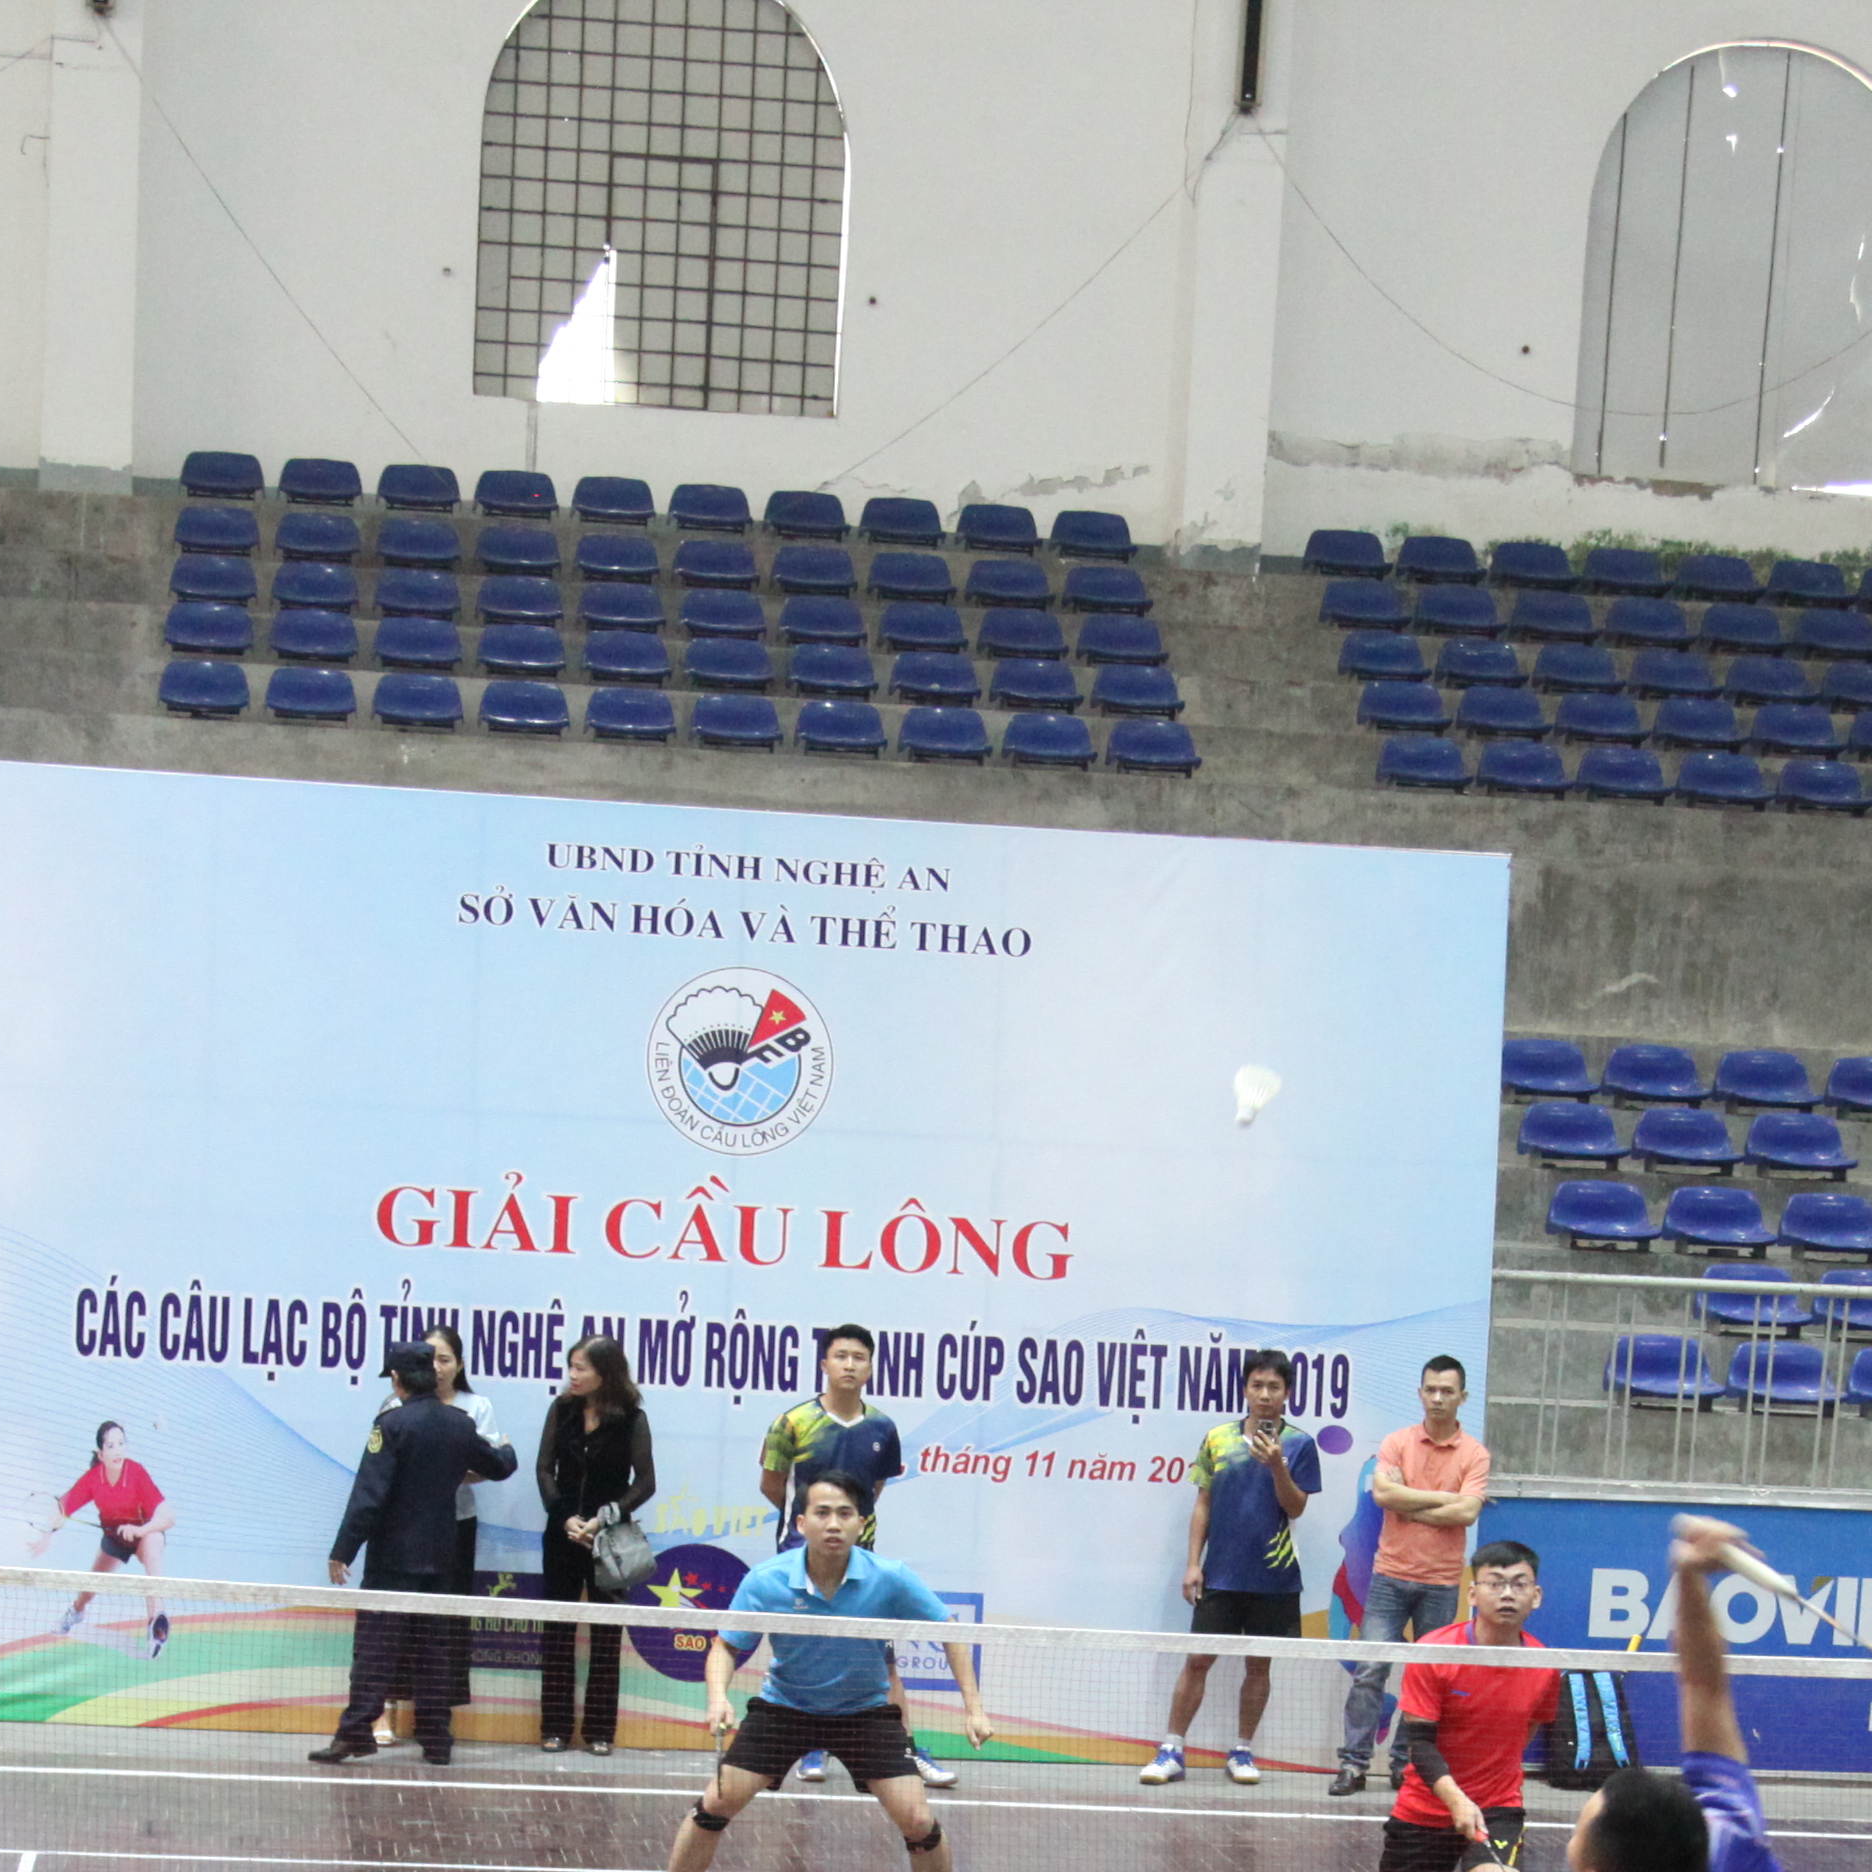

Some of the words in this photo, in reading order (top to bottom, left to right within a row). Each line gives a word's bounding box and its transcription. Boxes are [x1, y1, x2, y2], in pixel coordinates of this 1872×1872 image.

[546, 842, 655, 874] UBND
[665, 843, 762, 882] TỈNH
[775, 857, 886, 895] NGHỆ
[897, 866, 952, 892] AN
[458, 885, 515, 926] SỞ
[528, 895, 618, 932] VĂN
[630, 898, 725, 940] HÓA
[739, 905, 797, 944] VÀ
[810, 906, 899, 949] THỂ
[910, 921, 1033, 958] THAO
[810, 1046, 826, 1087] NAM
[376, 1171, 578, 1254] GIẢI
[604, 1174, 794, 1267] CẦU
[817, 1197, 1075, 1280] LÔNG
[75, 1276, 147, 1359] CÁC
[159, 1279, 231, 1363] CÂU
[241, 1297, 309, 1382] LẠC
[319, 1288, 368, 1385] BỘ
[471, 1298, 566, 1395] NGHỆ
[637, 1290, 696, 1388] MỞ
[705, 1308, 799, 1406] RỘNG
[812, 1326, 925, 1398] TNH
[936, 1319, 1005, 1401] CÚP
[1016, 1336, 1085, 1407] SAO
[1096, 1328, 1168, 1424] VIỆT
[1281, 1351, 1350, 1419] 019
[919, 1445, 1013, 1482] tháng
[1026, 1450, 1056, 1478] 11
[1067, 1452, 1137, 1482] năm
[674, 1633, 706, 1651] SAO
